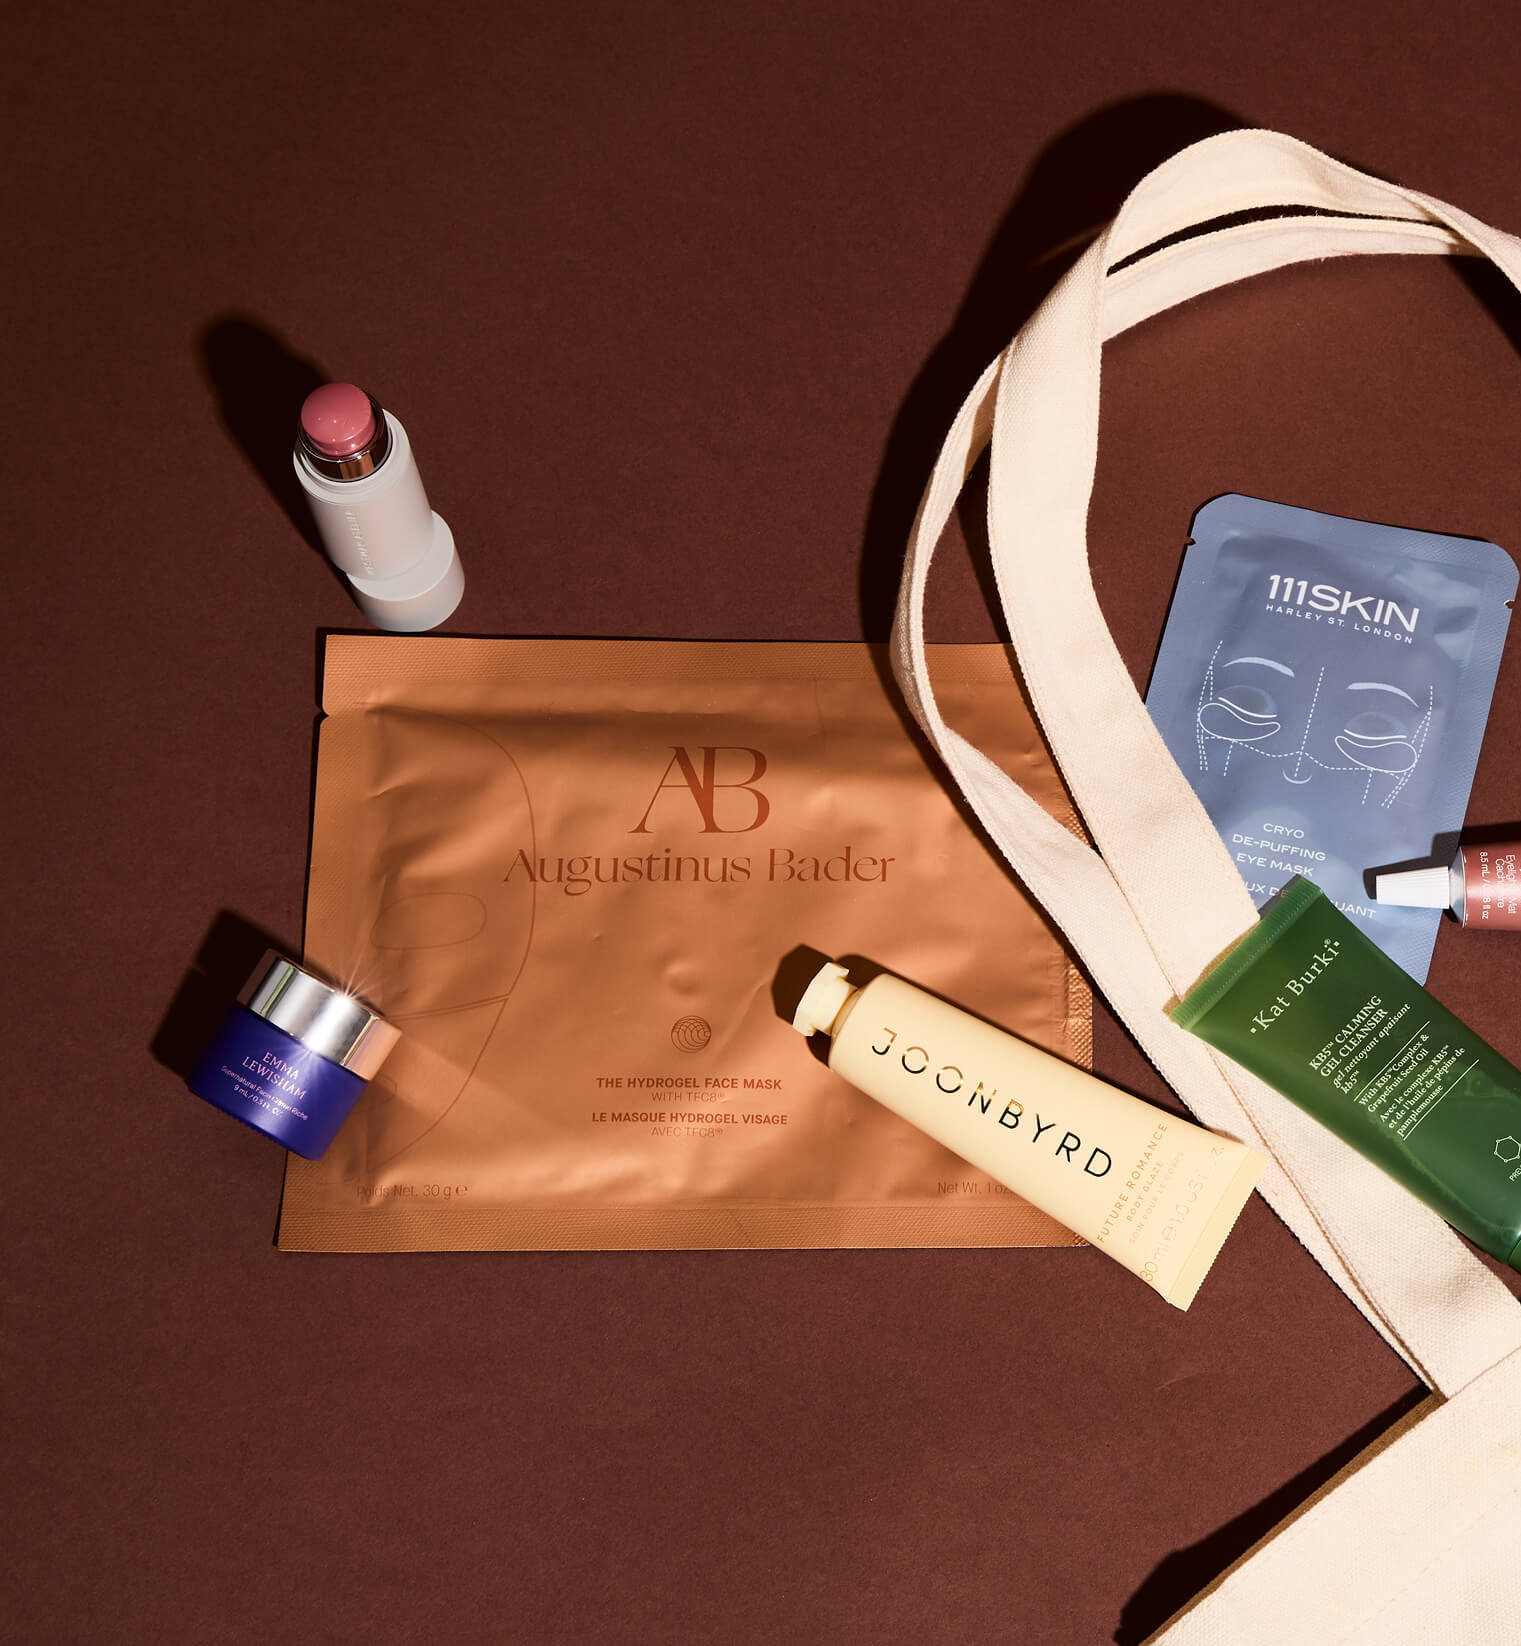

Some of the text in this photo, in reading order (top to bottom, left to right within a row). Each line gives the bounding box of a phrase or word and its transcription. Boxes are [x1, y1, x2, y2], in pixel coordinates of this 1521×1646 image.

[1265, 603, 1413, 644] HARLEY ST. LONDON
[1268, 574, 1420, 633] 111SKIN
[627, 746, 770, 834] AB
[1232, 833, 1327, 862] DE-PUFFING
[1263, 823, 1305, 840] CRYO
[503, 846, 896, 897] Augustinus Bader
[1237, 852, 1314, 877] EYE MASK
[1252, 996, 1290, 1031] Kat
[1334, 995, 1382, 1044] CALMING
[262, 1051, 300, 1081] EMMA
[1320, 1008, 1389, 1077] GEL CLEANSER
[1333, 1003, 1411, 1089] gel nettoyant apaisant
[233, 1083, 241, 1092] 9
[596, 1077, 782, 1090] THE HYDROGEL FACE MASK
[1359, 1085, 1378, 1106] With
[1391, 1041, 1423, 1072] Complex
[1420, 1034, 1430, 1042] &
[1367, 1048, 1430, 1113] Grapefruit Seed Oil
[1380, 1103, 1398, 1122] Avec
[1394, 1095, 1405, 1105] le
[1403, 1063, 1435, 1097] complexe
[1388, 1119, 1398, 1129] et
[1395, 1109, 1407, 1120] de
[1425, 1077, 1436, 1089] de
[1434, 1056, 1457, 1081] pépins
[1455, 1047, 1466, 1057] de
[592, 1112, 788, 1126] LE MASQUE HYDROGEL VISAGE
[651, 1092, 682, 1103] WITH
[871, 1027, 1112, 1178] JOONBYRD
[1396, 1084, 1444, 1138] pamplemousse
[651, 1127, 681, 1137] AVEC
[393, 1184, 419, 1198] Net.
[422, 1184, 440, 1198] 30
[442, 1185, 452, 1200] g
[937, 1182, 959, 1194] Net
[962, 1181, 982, 1194] Wt.
[1097, 1123, 1168, 1244] FUTURE ROMANCE
[1126, 1161, 1163, 1223] BODY GLAZE
